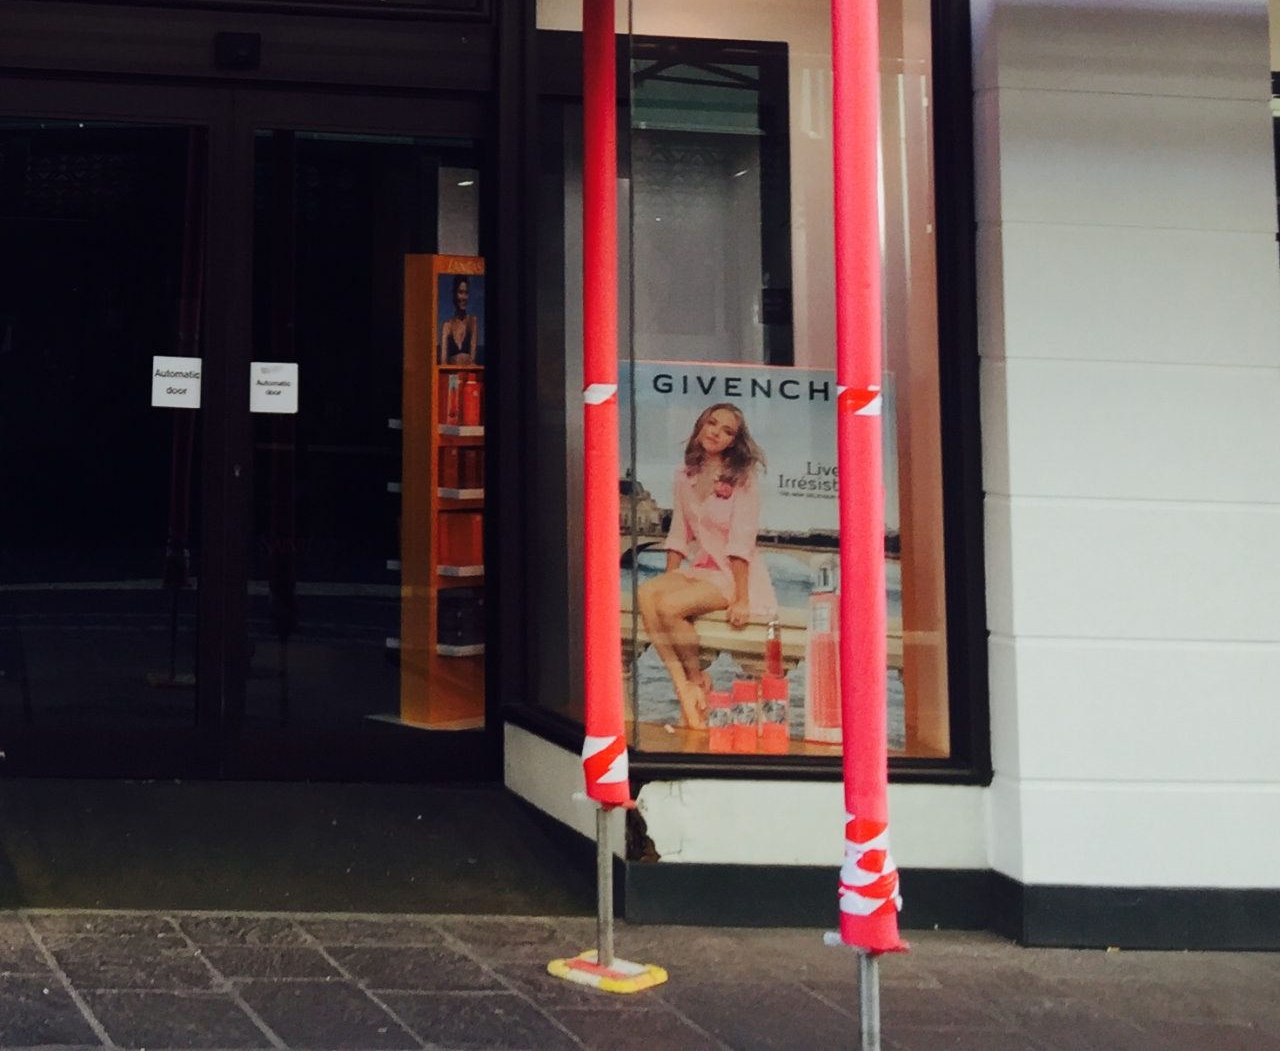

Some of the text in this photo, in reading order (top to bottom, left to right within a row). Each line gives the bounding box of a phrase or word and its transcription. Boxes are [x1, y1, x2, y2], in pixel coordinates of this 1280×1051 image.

[154, 368, 201, 380] Automatic
[255, 379, 292, 387] Automatic
[653, 373, 834, 402] GIVENCH
[166, 386, 188, 396] door
[265, 389, 282, 397] door
[806, 461, 838, 477] Live
[777, 474, 838, 492] Irrésist
